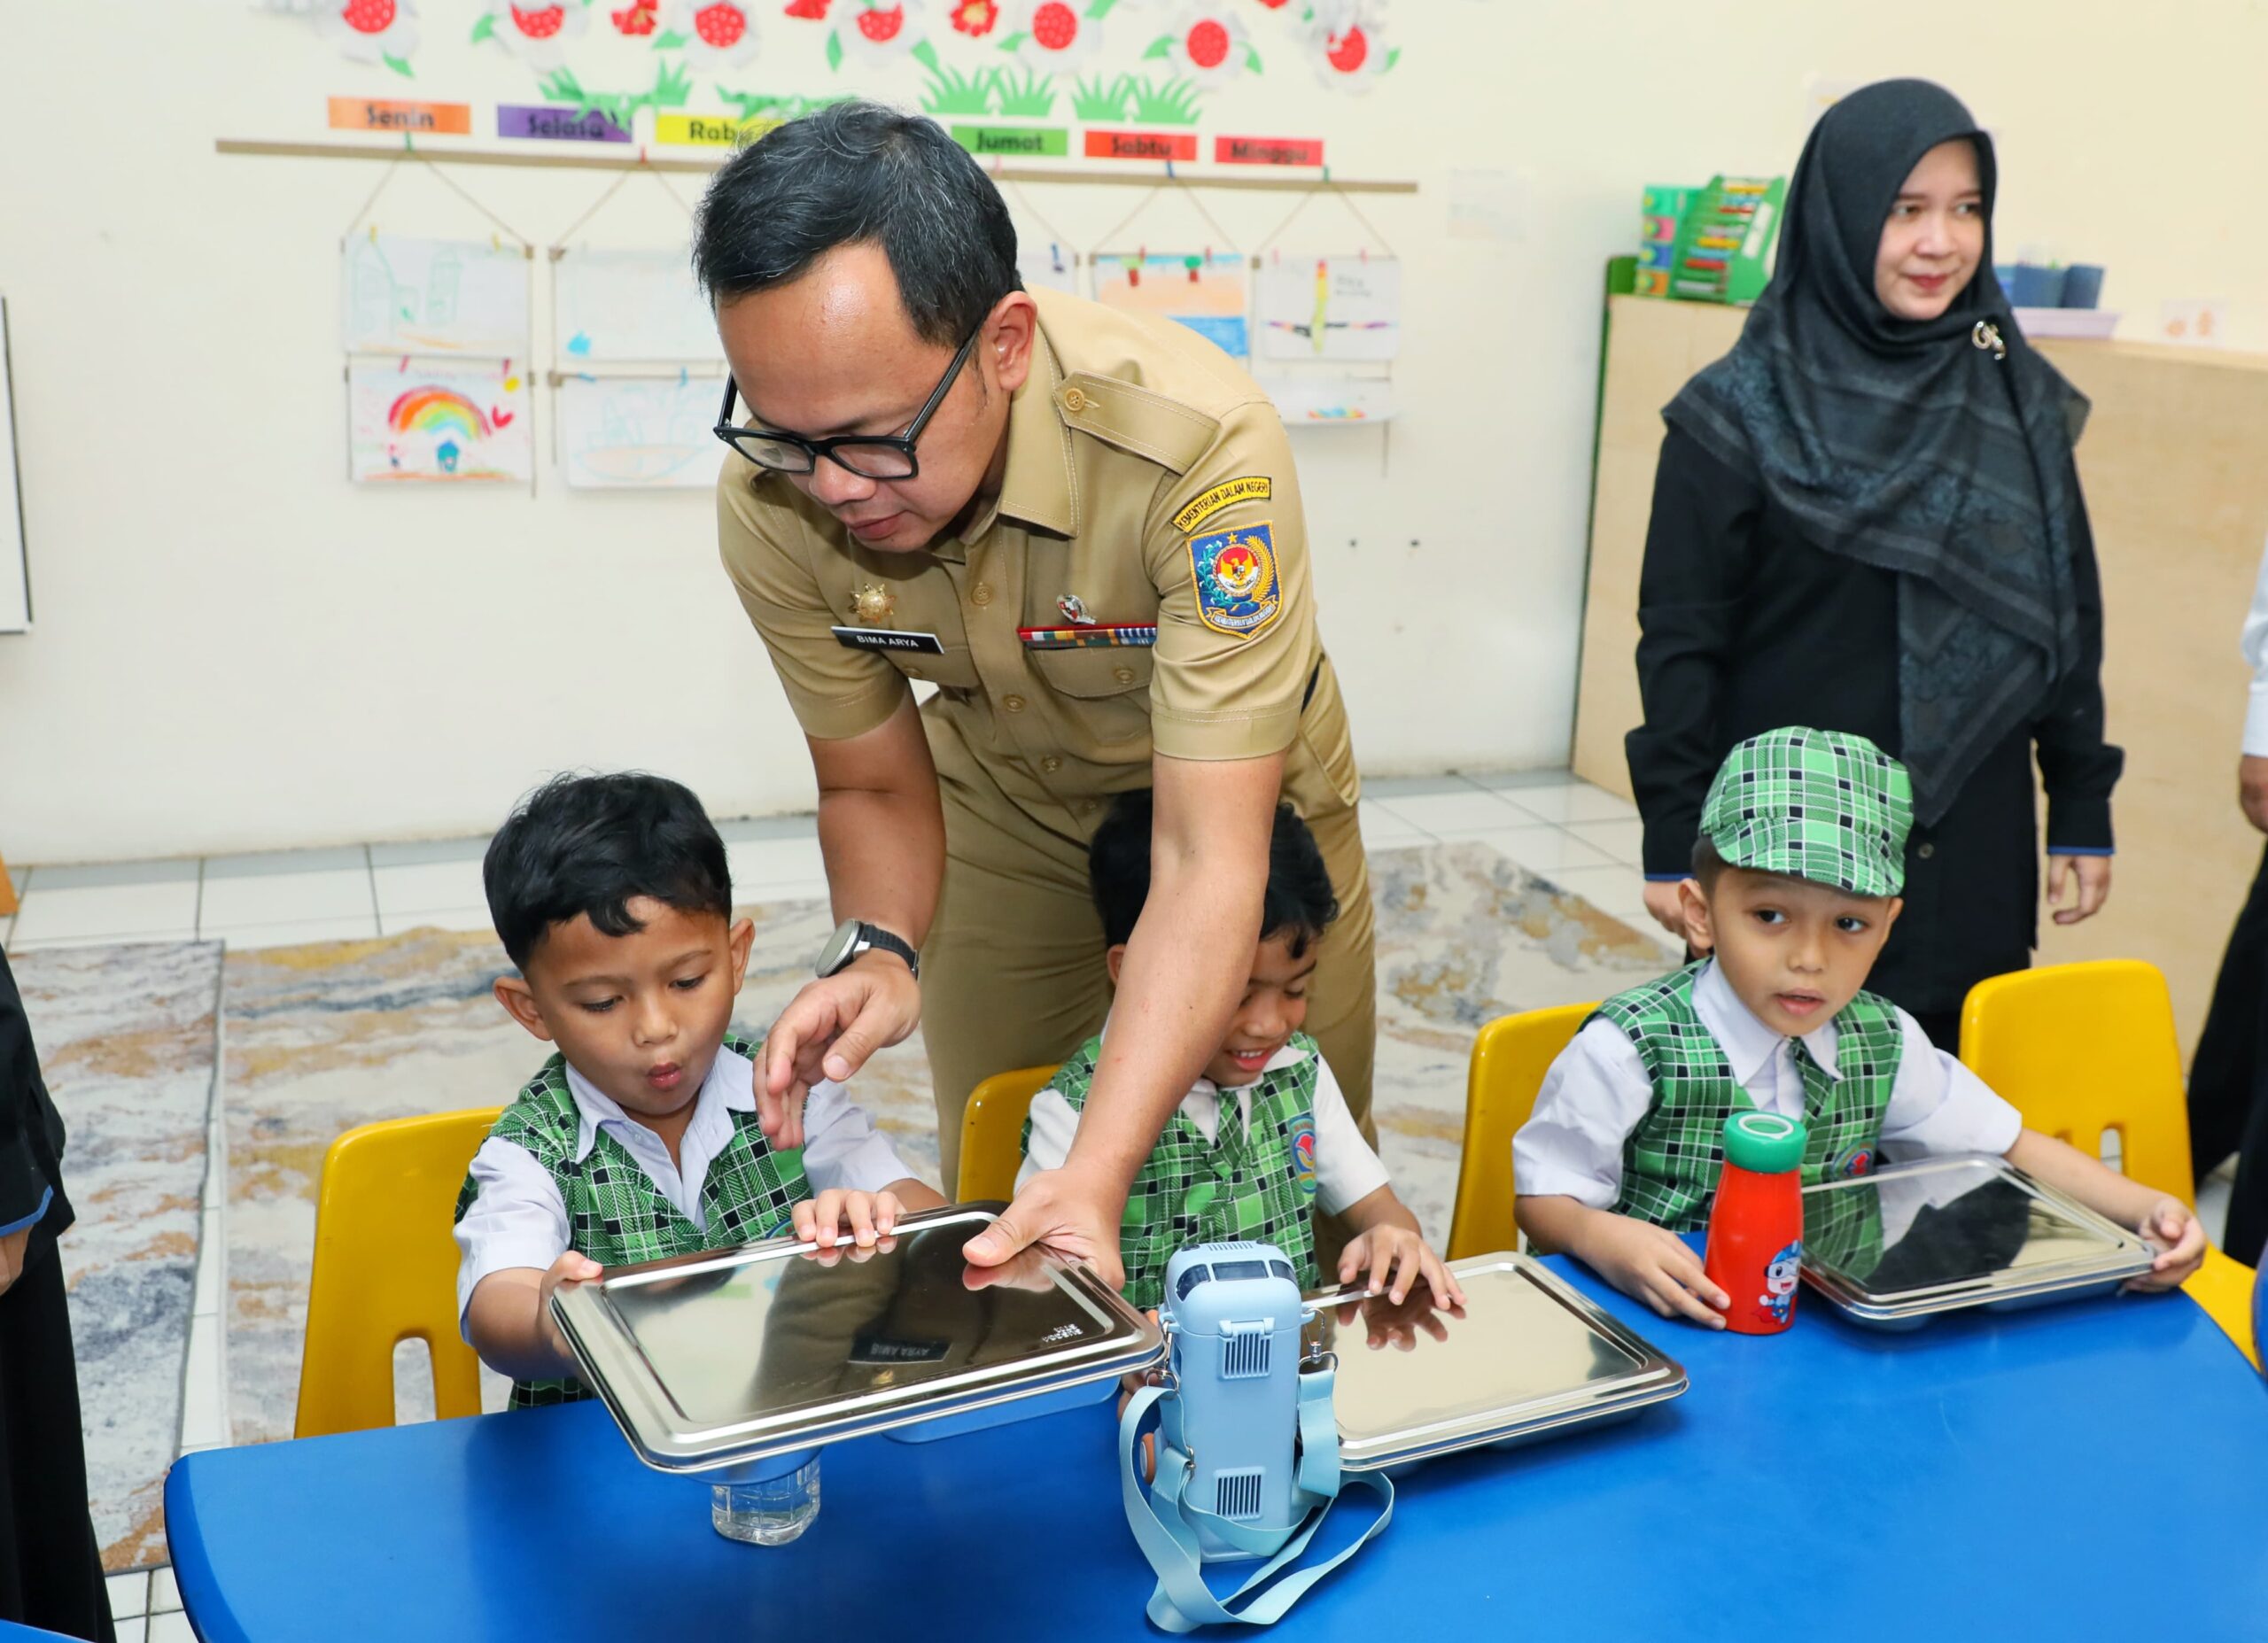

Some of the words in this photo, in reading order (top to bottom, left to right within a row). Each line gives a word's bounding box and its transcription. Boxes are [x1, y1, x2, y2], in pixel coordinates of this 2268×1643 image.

[367, 104, 435, 128] Senin
[527, 113, 605, 138] Selasa
[689, 120, 742, 141] Rab
[976, 128, 1043, 151] Jumat
[1113, 135, 1172, 156] Sabtu
[1231, 141, 1308, 165] Minggu
[1177, 491, 1221, 528] KEMENTERIAN
[1219, 481, 1245, 500] DALAM
[1246, 480, 1268, 493] NEGERI
[856, 634, 887, 645] BIMA
[889, 637, 920, 647] ARYA
